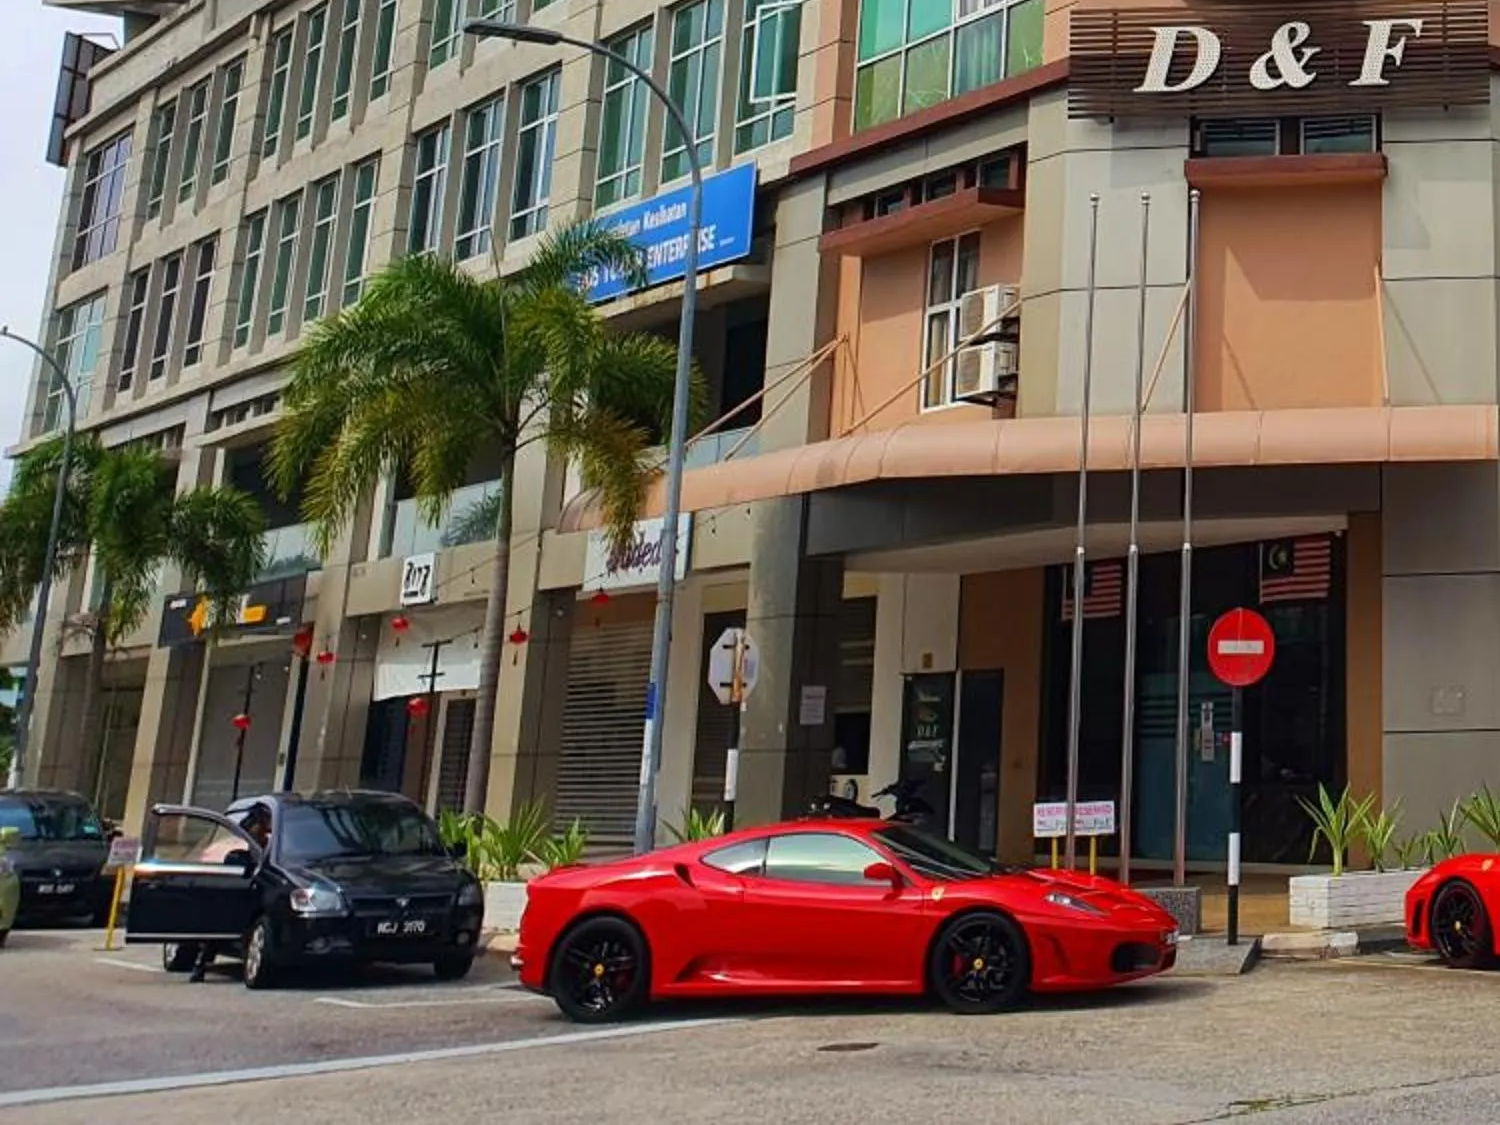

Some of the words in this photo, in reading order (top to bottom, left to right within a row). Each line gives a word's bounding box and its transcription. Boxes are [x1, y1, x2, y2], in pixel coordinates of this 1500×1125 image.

[1133, 25, 1221, 92] D
[1348, 19, 1424, 85] F
[647, 225, 717, 269] ENTERPISE
